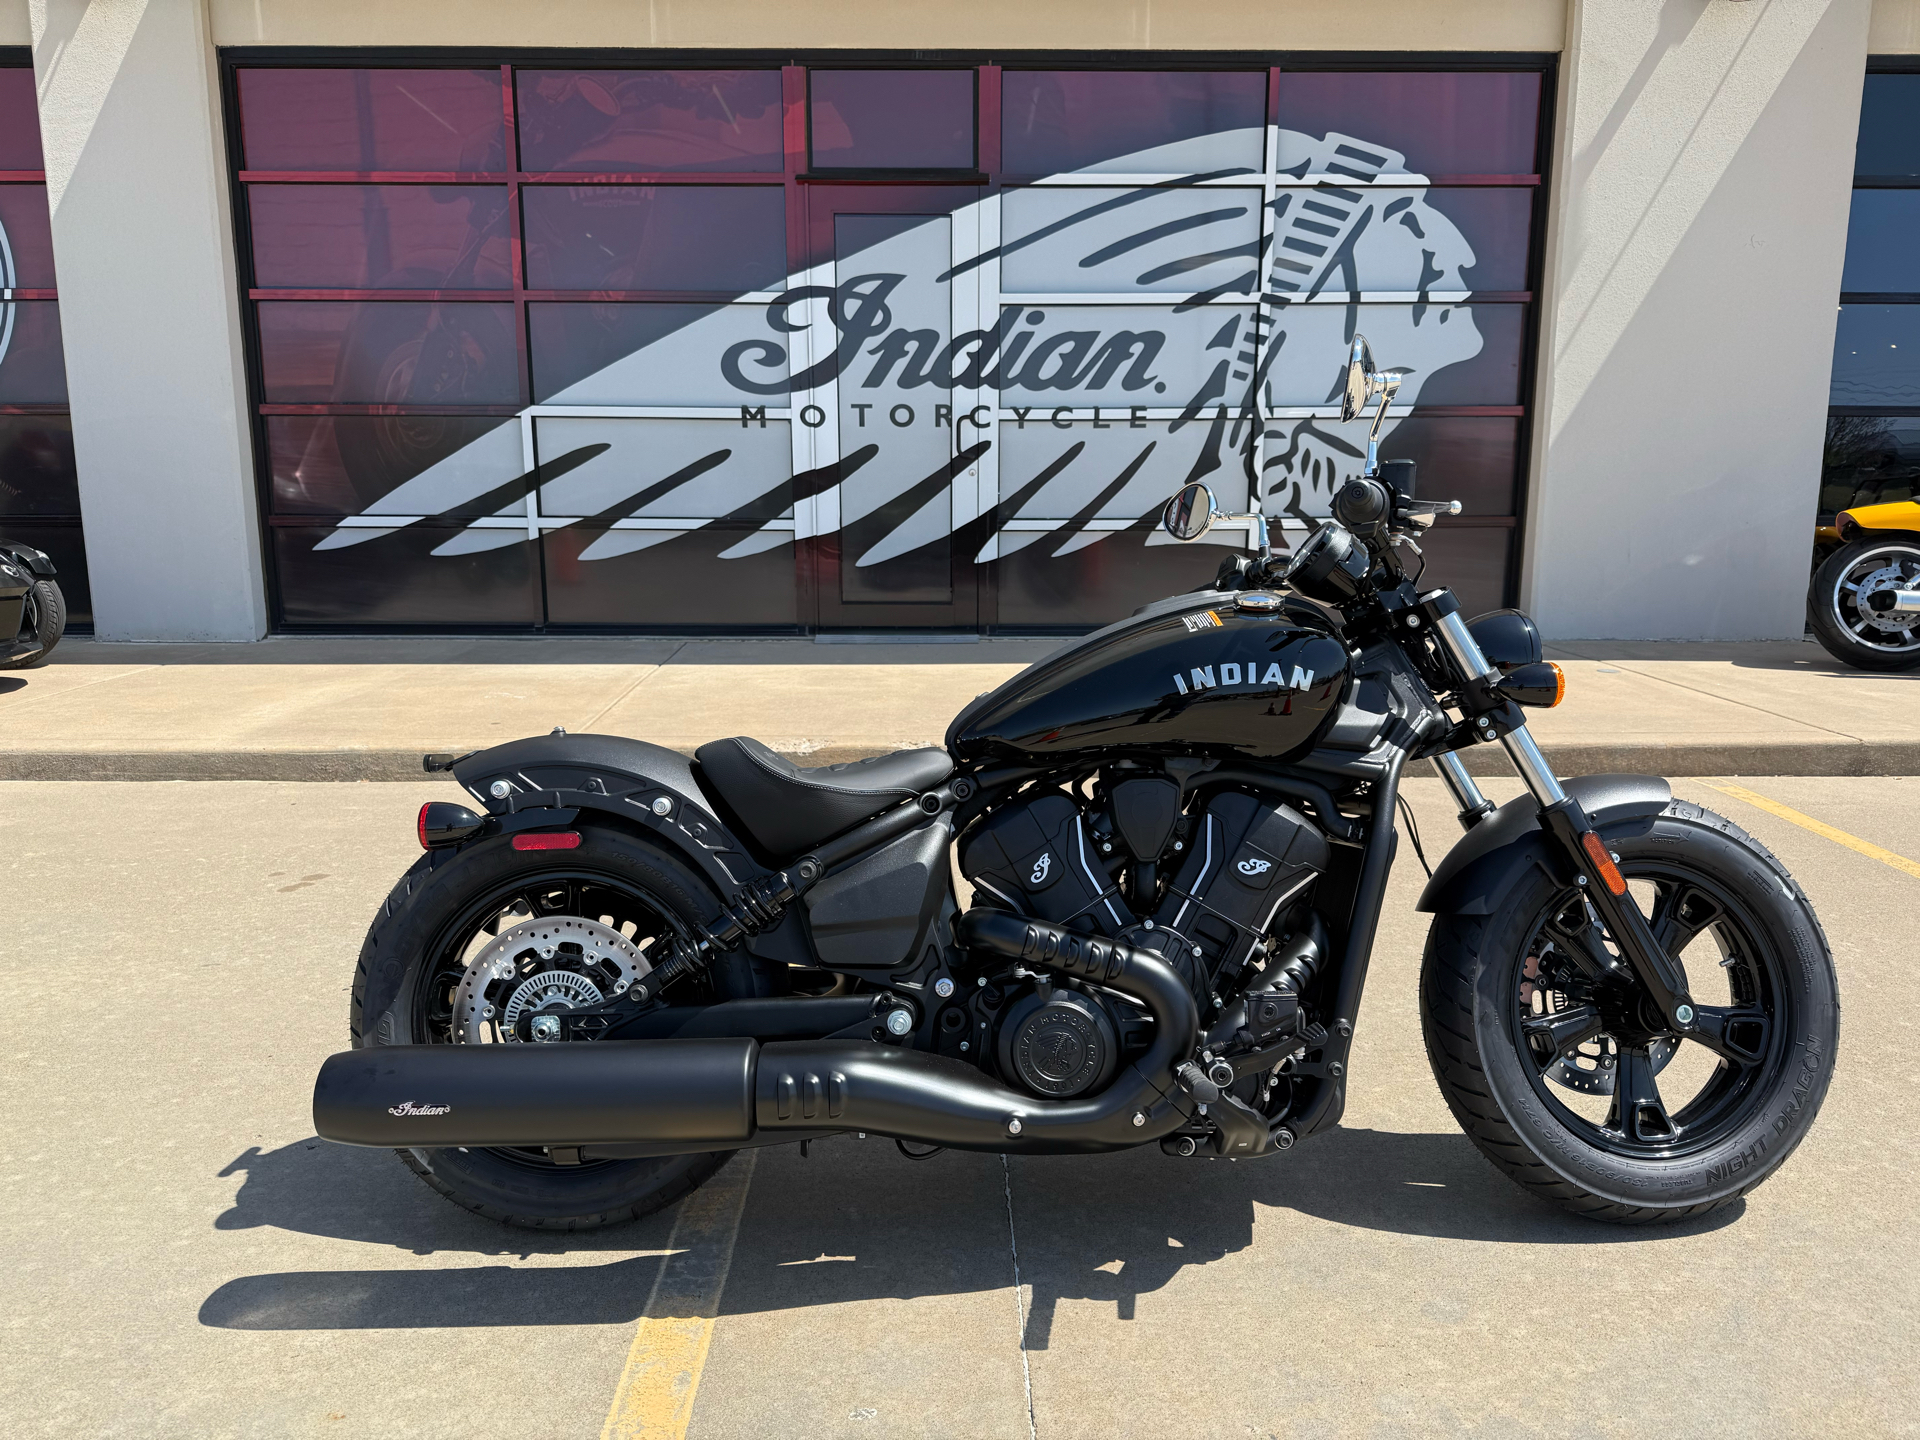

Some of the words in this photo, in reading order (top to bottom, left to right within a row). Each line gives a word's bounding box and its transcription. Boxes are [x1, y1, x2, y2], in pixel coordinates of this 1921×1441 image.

[741, 403, 1148, 429] MOTORCYCLE
[1173, 662, 1315, 696] INDIAN
[393, 1100, 444, 1117] Indian
[1705, 1134, 1768, 1187] NIGHT
[1771, 1034, 1823, 1137] DRAGON
